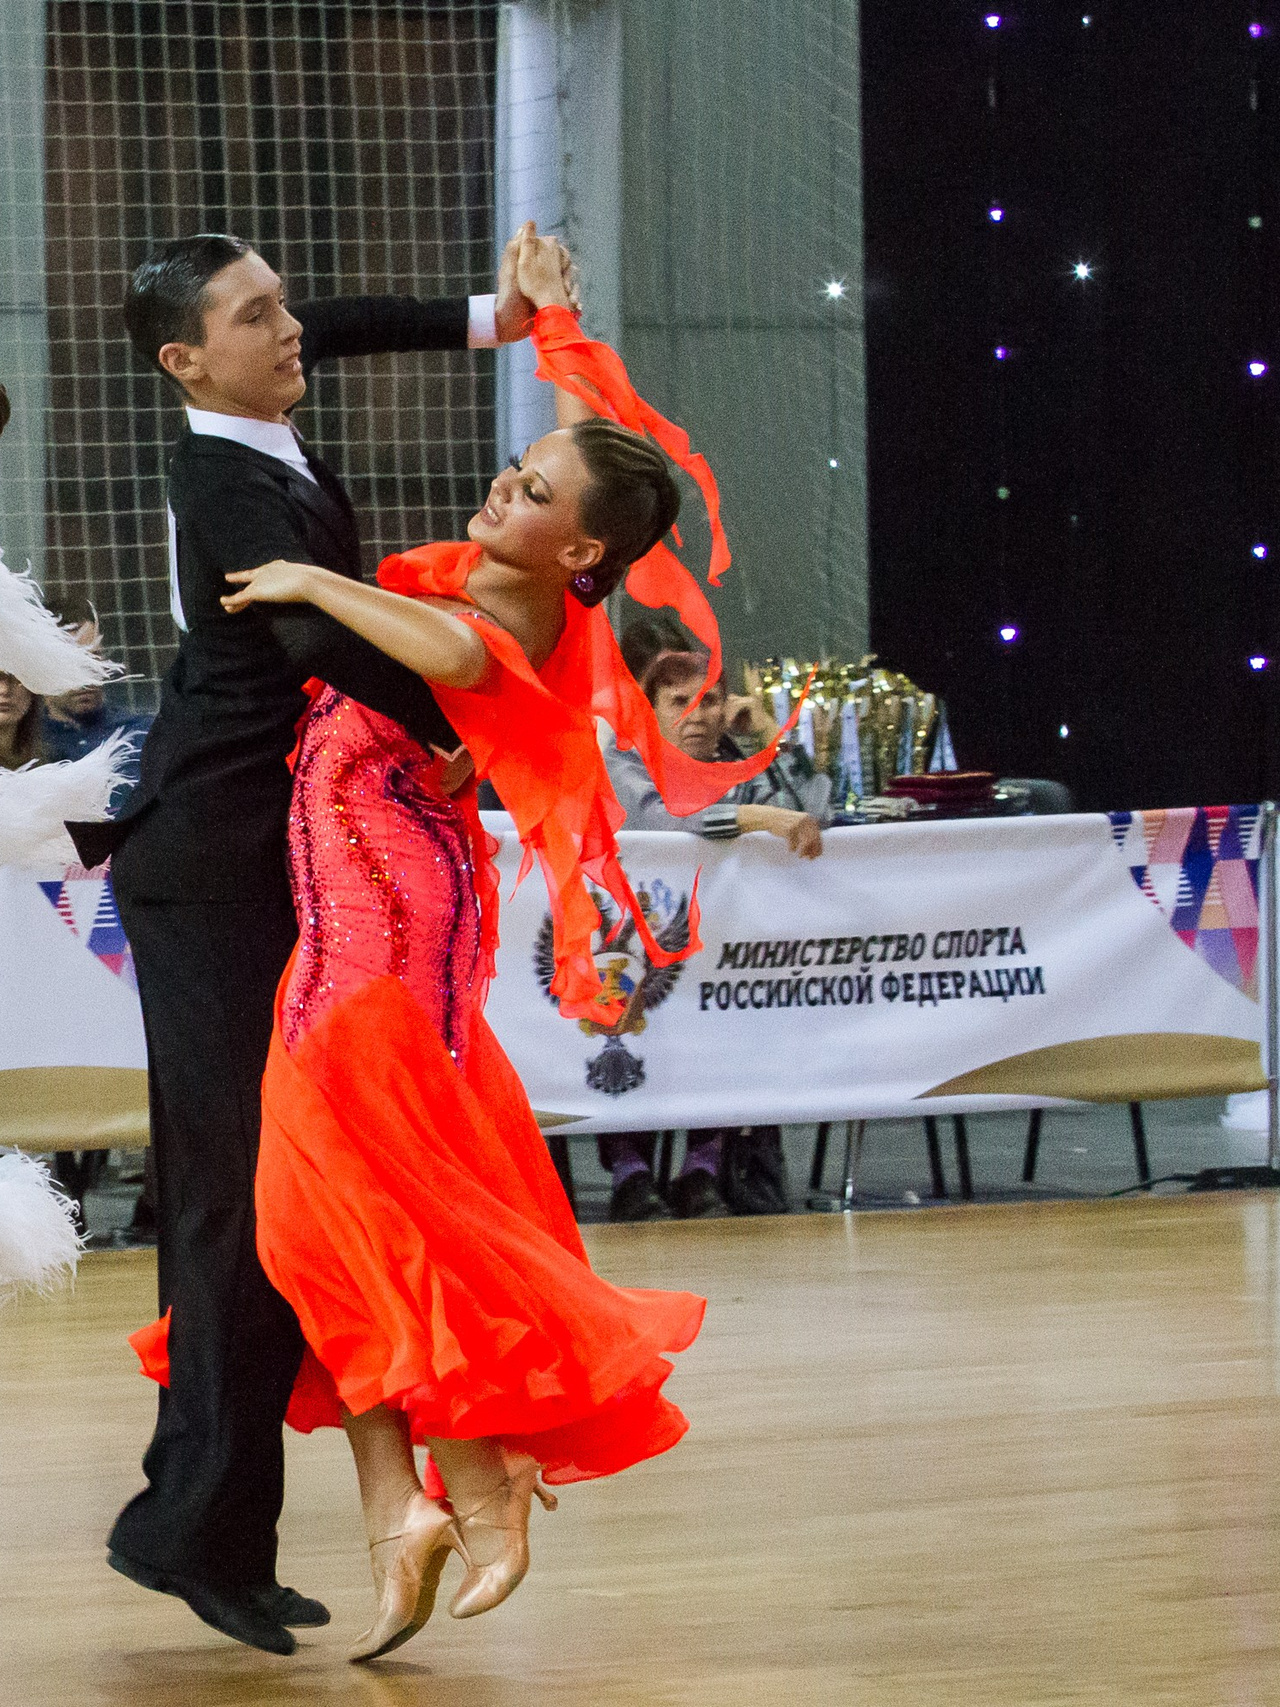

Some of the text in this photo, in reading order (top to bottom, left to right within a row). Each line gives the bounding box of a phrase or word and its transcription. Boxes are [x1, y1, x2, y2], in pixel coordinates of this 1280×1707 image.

[717, 926, 1026, 969] МИНИСТЕРСТВО СПОРТА
[699, 966, 1045, 1010] РОССИЙСКОЙ ФЕДЕРАЦИИ
